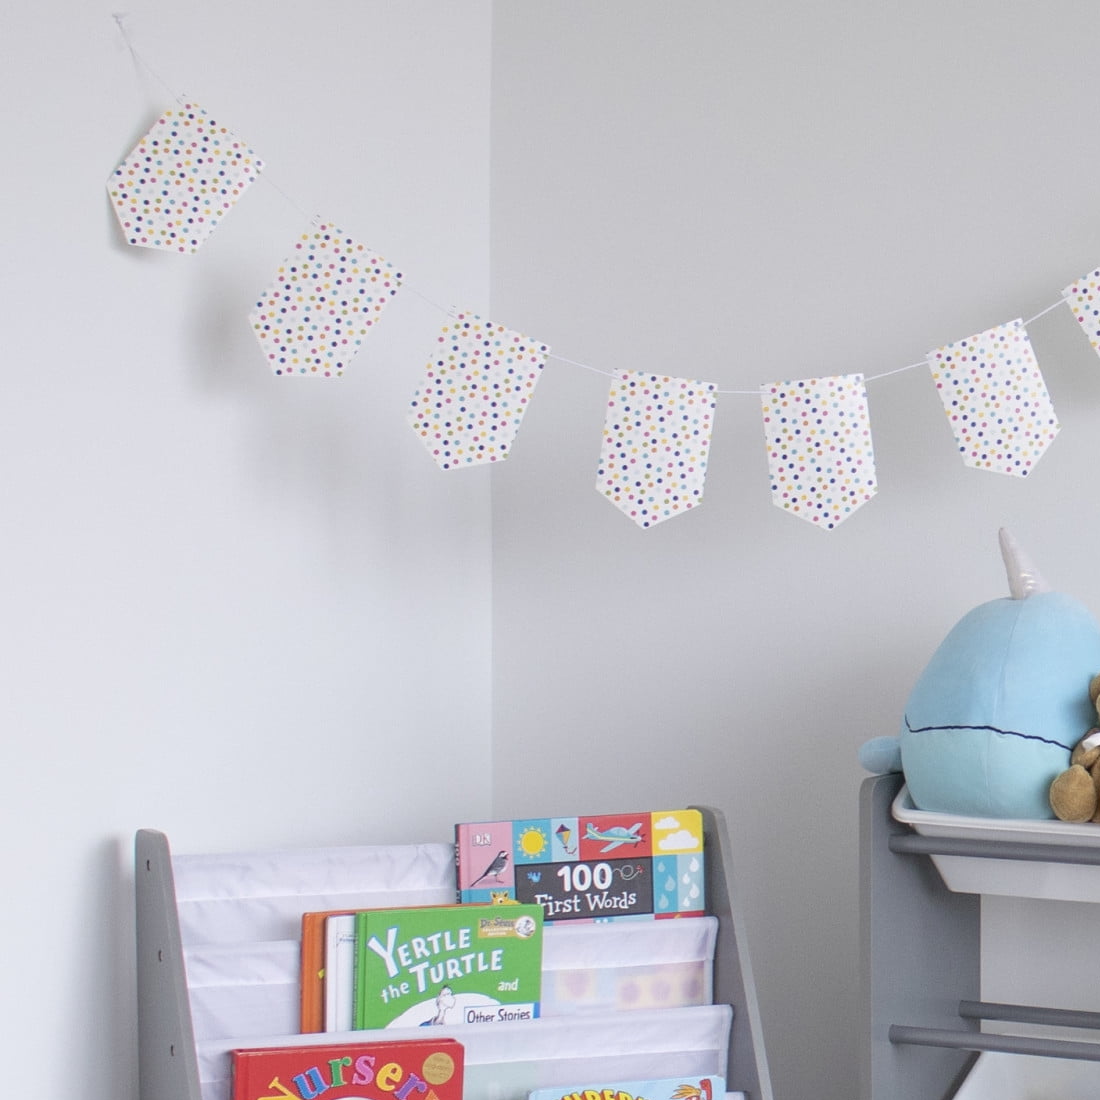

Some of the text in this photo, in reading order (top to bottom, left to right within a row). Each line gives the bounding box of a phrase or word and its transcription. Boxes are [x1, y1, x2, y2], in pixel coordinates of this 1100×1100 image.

[557, 863, 613, 892] 100
[535, 891, 637, 916] First Words
[367, 926, 472, 978] YERTLE
[380, 949, 504, 1003] the TURTLE
[498, 978, 519, 991] and
[467, 1007, 531, 1023] Other Stories
